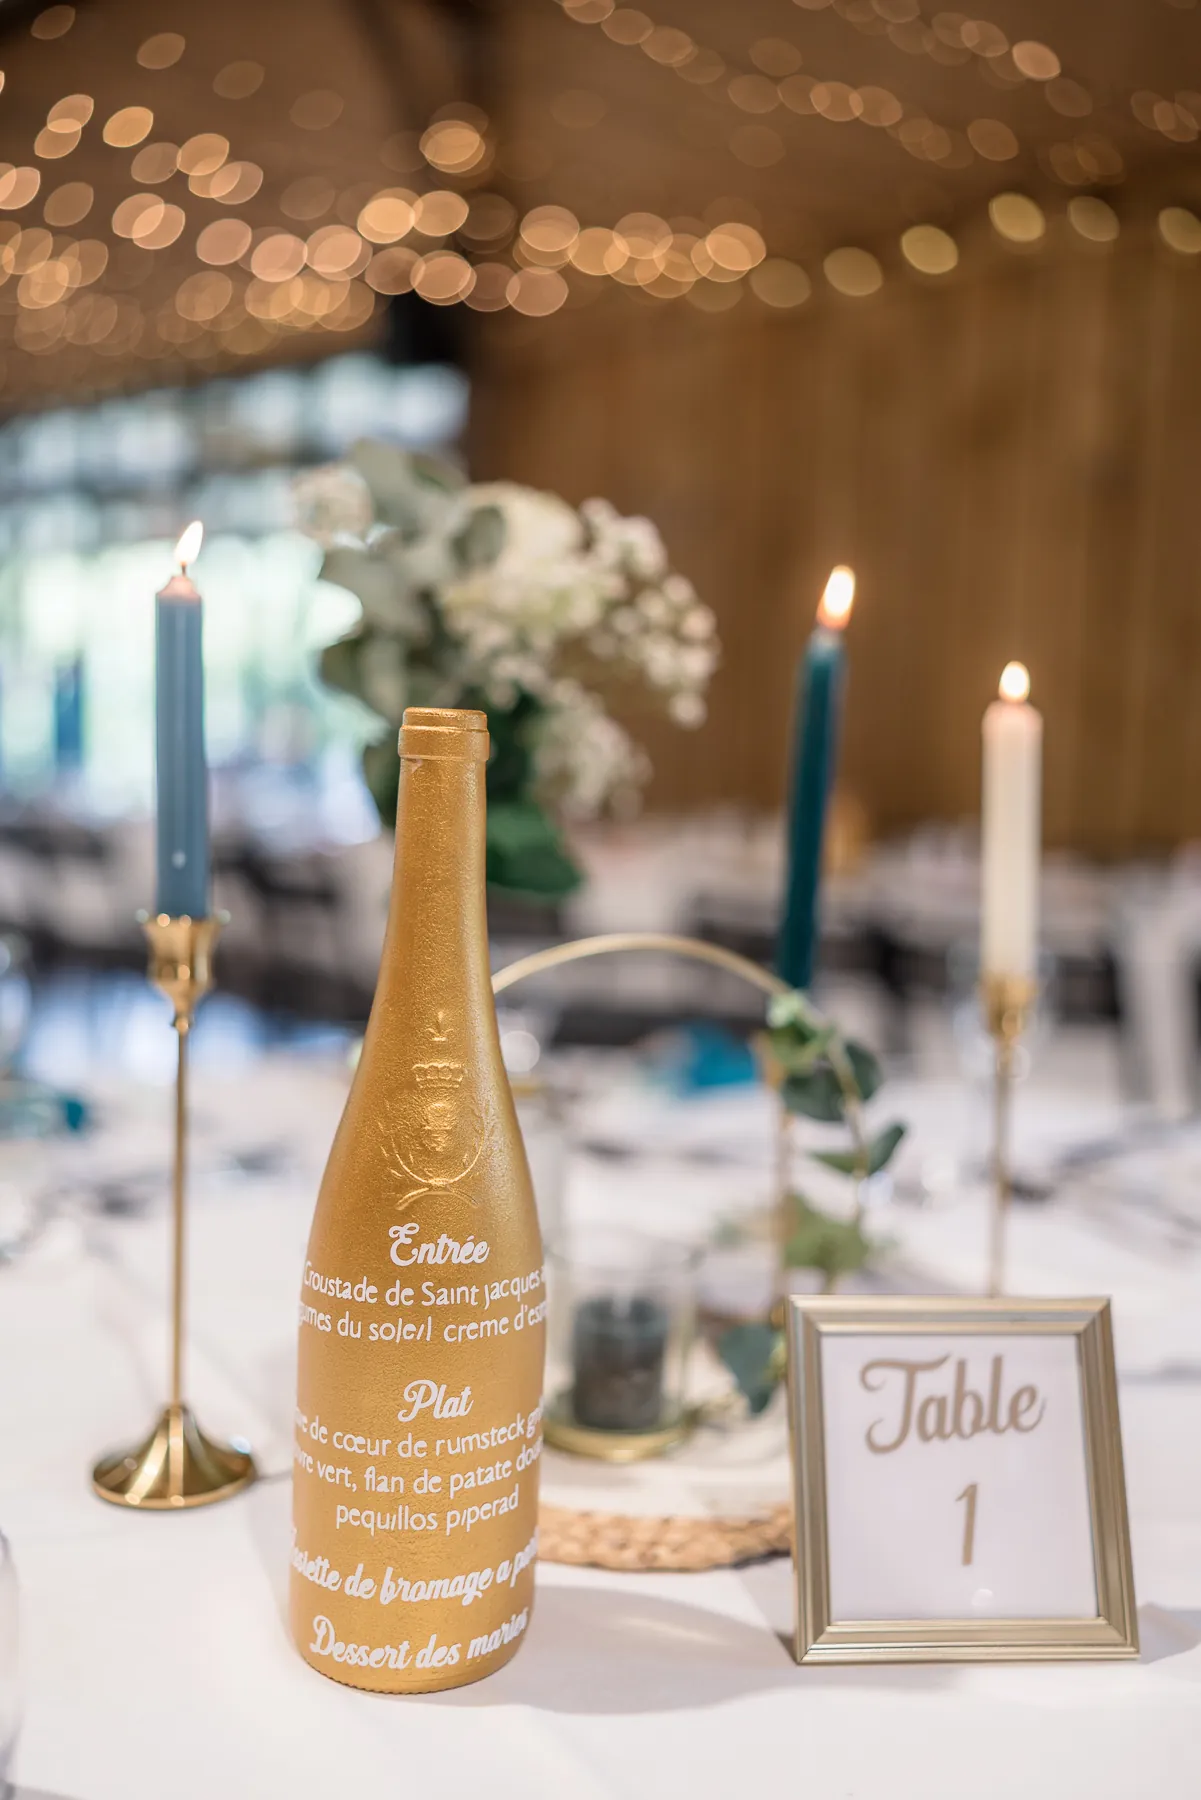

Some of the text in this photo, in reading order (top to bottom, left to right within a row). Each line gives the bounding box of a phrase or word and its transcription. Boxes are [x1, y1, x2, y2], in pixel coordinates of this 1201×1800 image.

[389, 1222, 490, 1267] Entrée
[304, 1260, 378, 1304] Croustade
[385, 1279, 414, 1306] de
[421, 1281, 479, 1307] Saint
[337, 1311, 361, 1339] du
[443, 1316, 509, 1343] creme
[397, 1379, 474, 1423] Plat
[860, 1352, 1047, 1454] Table
[309, 1415, 328, 1445] de
[333, 1431, 391, 1456] cœur
[397, 1432, 427, 1458] de
[435, 1413, 524, 1456] rumsteck
[317, 1460, 357, 1493] vert,
[413, 1468, 442, 1494] de
[450, 1459, 512, 1499] patate
[336, 1505, 438, 1537] pequillos
[955, 1481, 979, 1566] 1
[345, 1563, 377, 1599] de
[309, 1615, 413, 1669] Dessert
[415, 1634, 462, 1669] des
